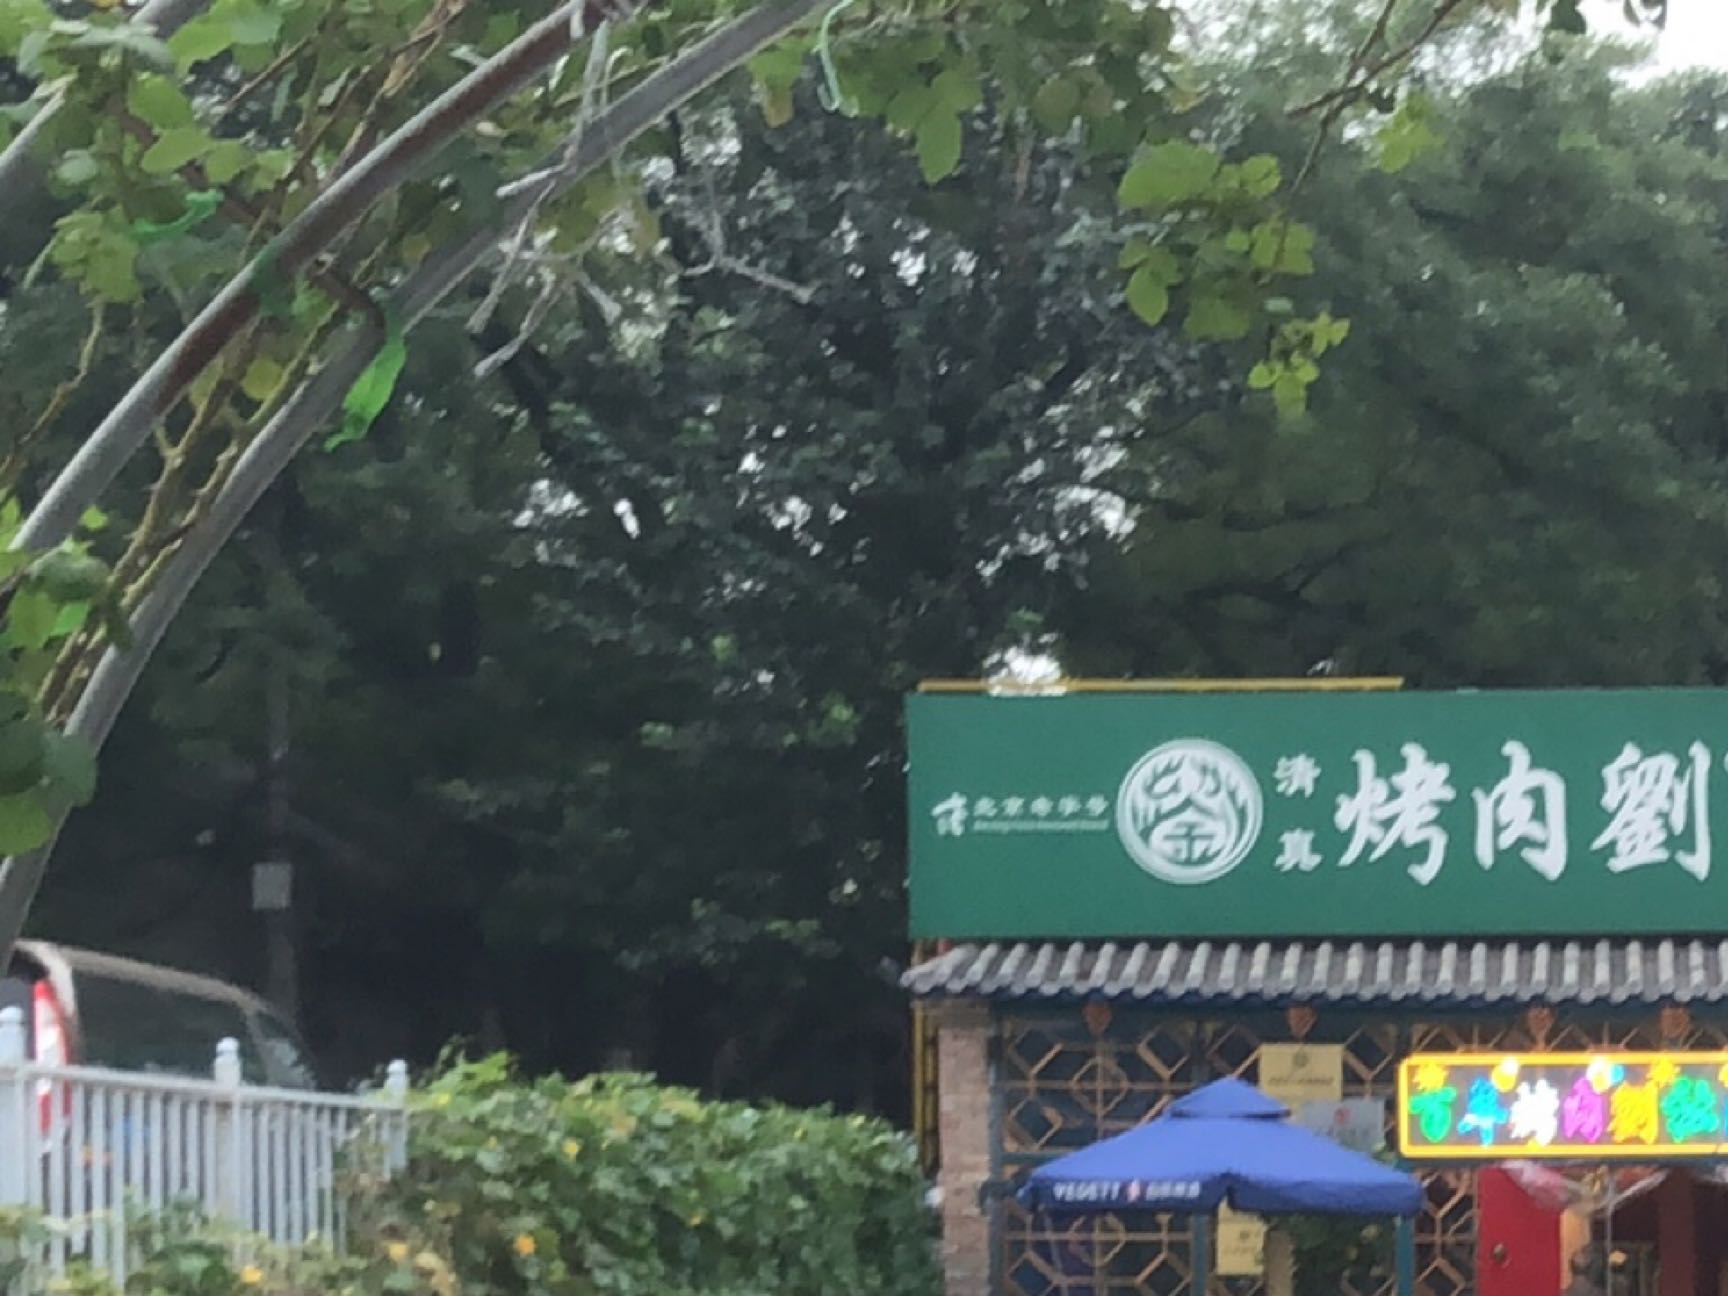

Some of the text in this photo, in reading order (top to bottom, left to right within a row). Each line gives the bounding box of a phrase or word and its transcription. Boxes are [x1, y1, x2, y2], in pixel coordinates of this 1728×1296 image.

[1274, 753, 1322, 871] 清真
[1334, 740, 1711, 885] 烤肉劉
